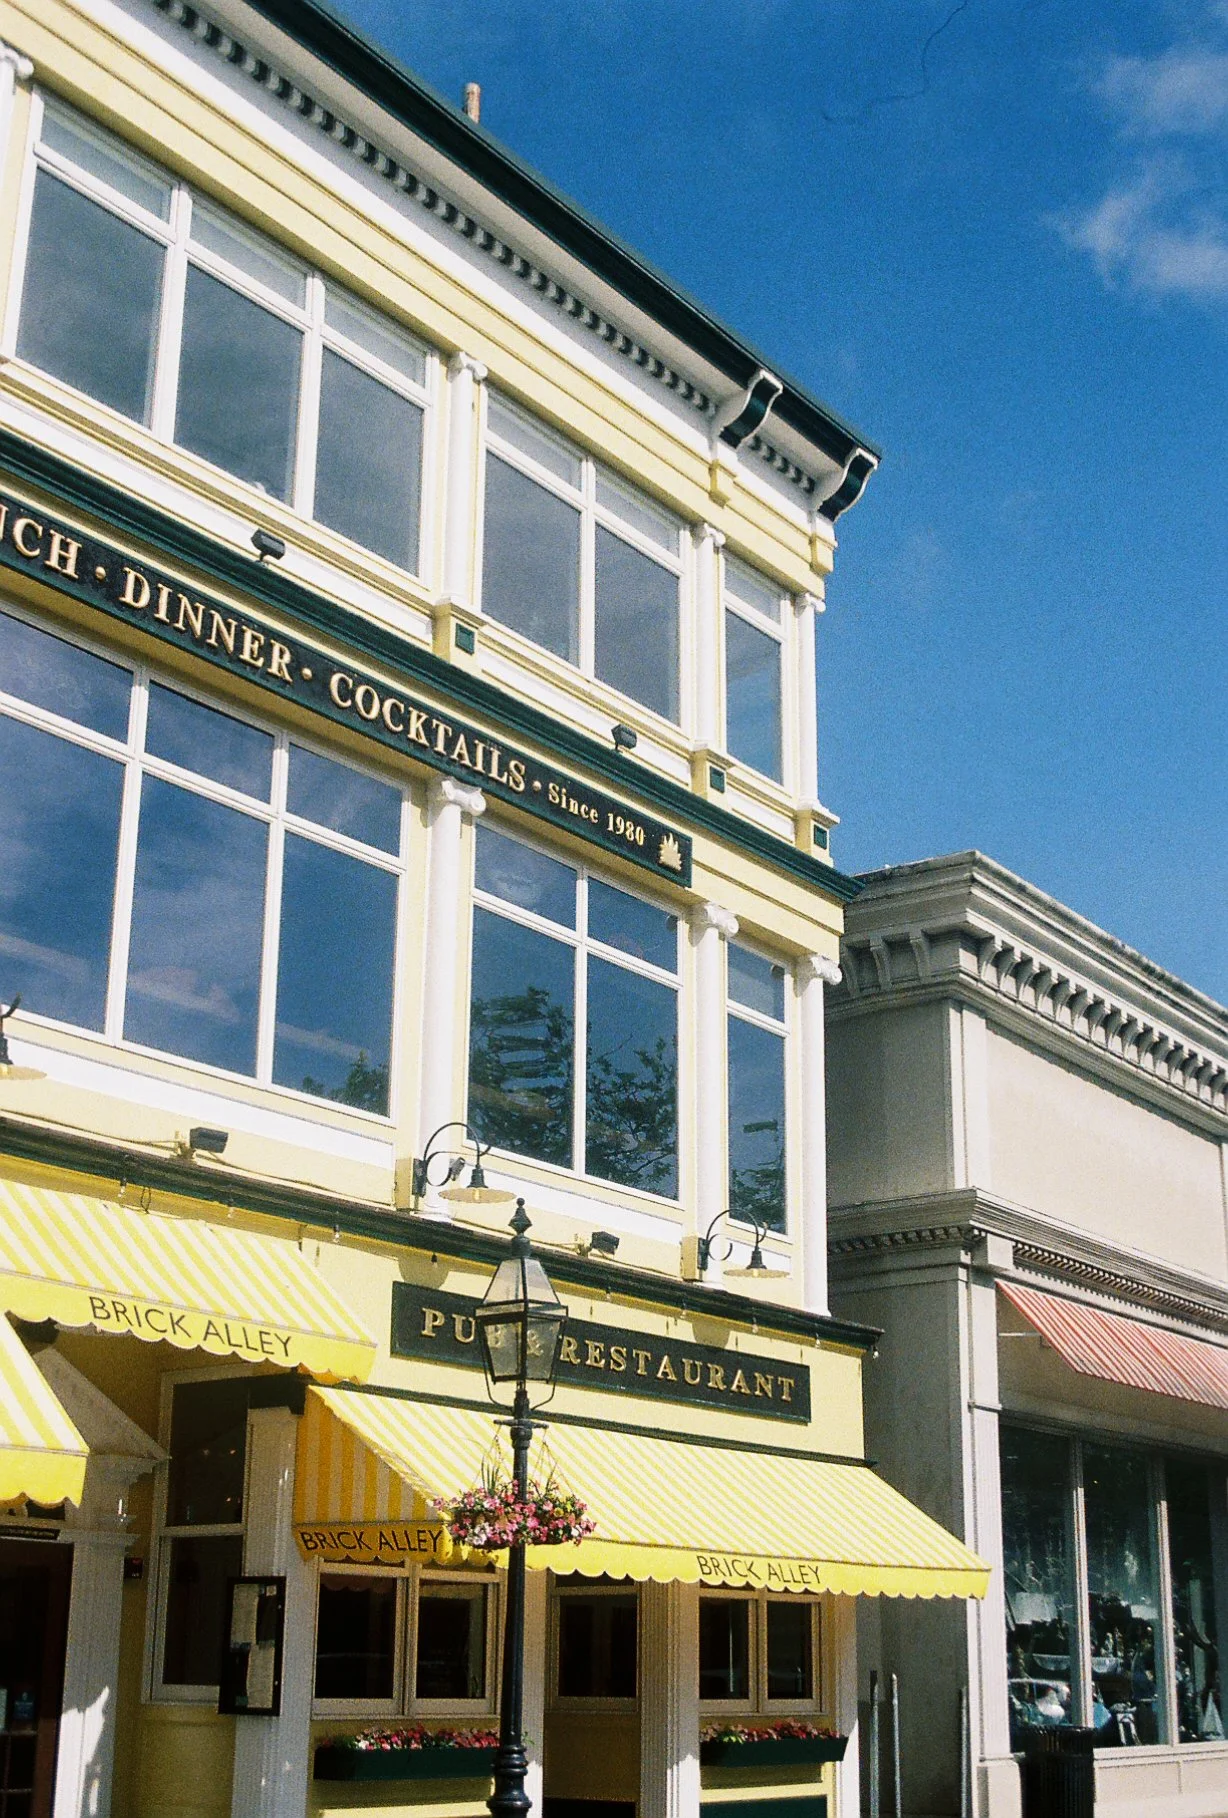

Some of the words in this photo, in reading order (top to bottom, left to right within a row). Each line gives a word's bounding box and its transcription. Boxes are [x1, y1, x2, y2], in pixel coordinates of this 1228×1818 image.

[0, 503, 82, 579] CH
[119, 566, 294, 684] DINNER
[329, 672, 527, 794] COCKTAILS
[548, 782, 599, 824] Since
[607, 812, 645, 846] 1980
[89, 1296, 192, 1339] BRICK
[203, 1319, 292, 1357] ALLEY
[559, 1335, 796, 1402] RESTAURANT
[300, 1530, 372, 1551] BRICK
[378, 1529, 443, 1553] ALLEY
[697, 1555, 762, 1581] BRICK
[767, 1562, 821, 1585] ALLEY
